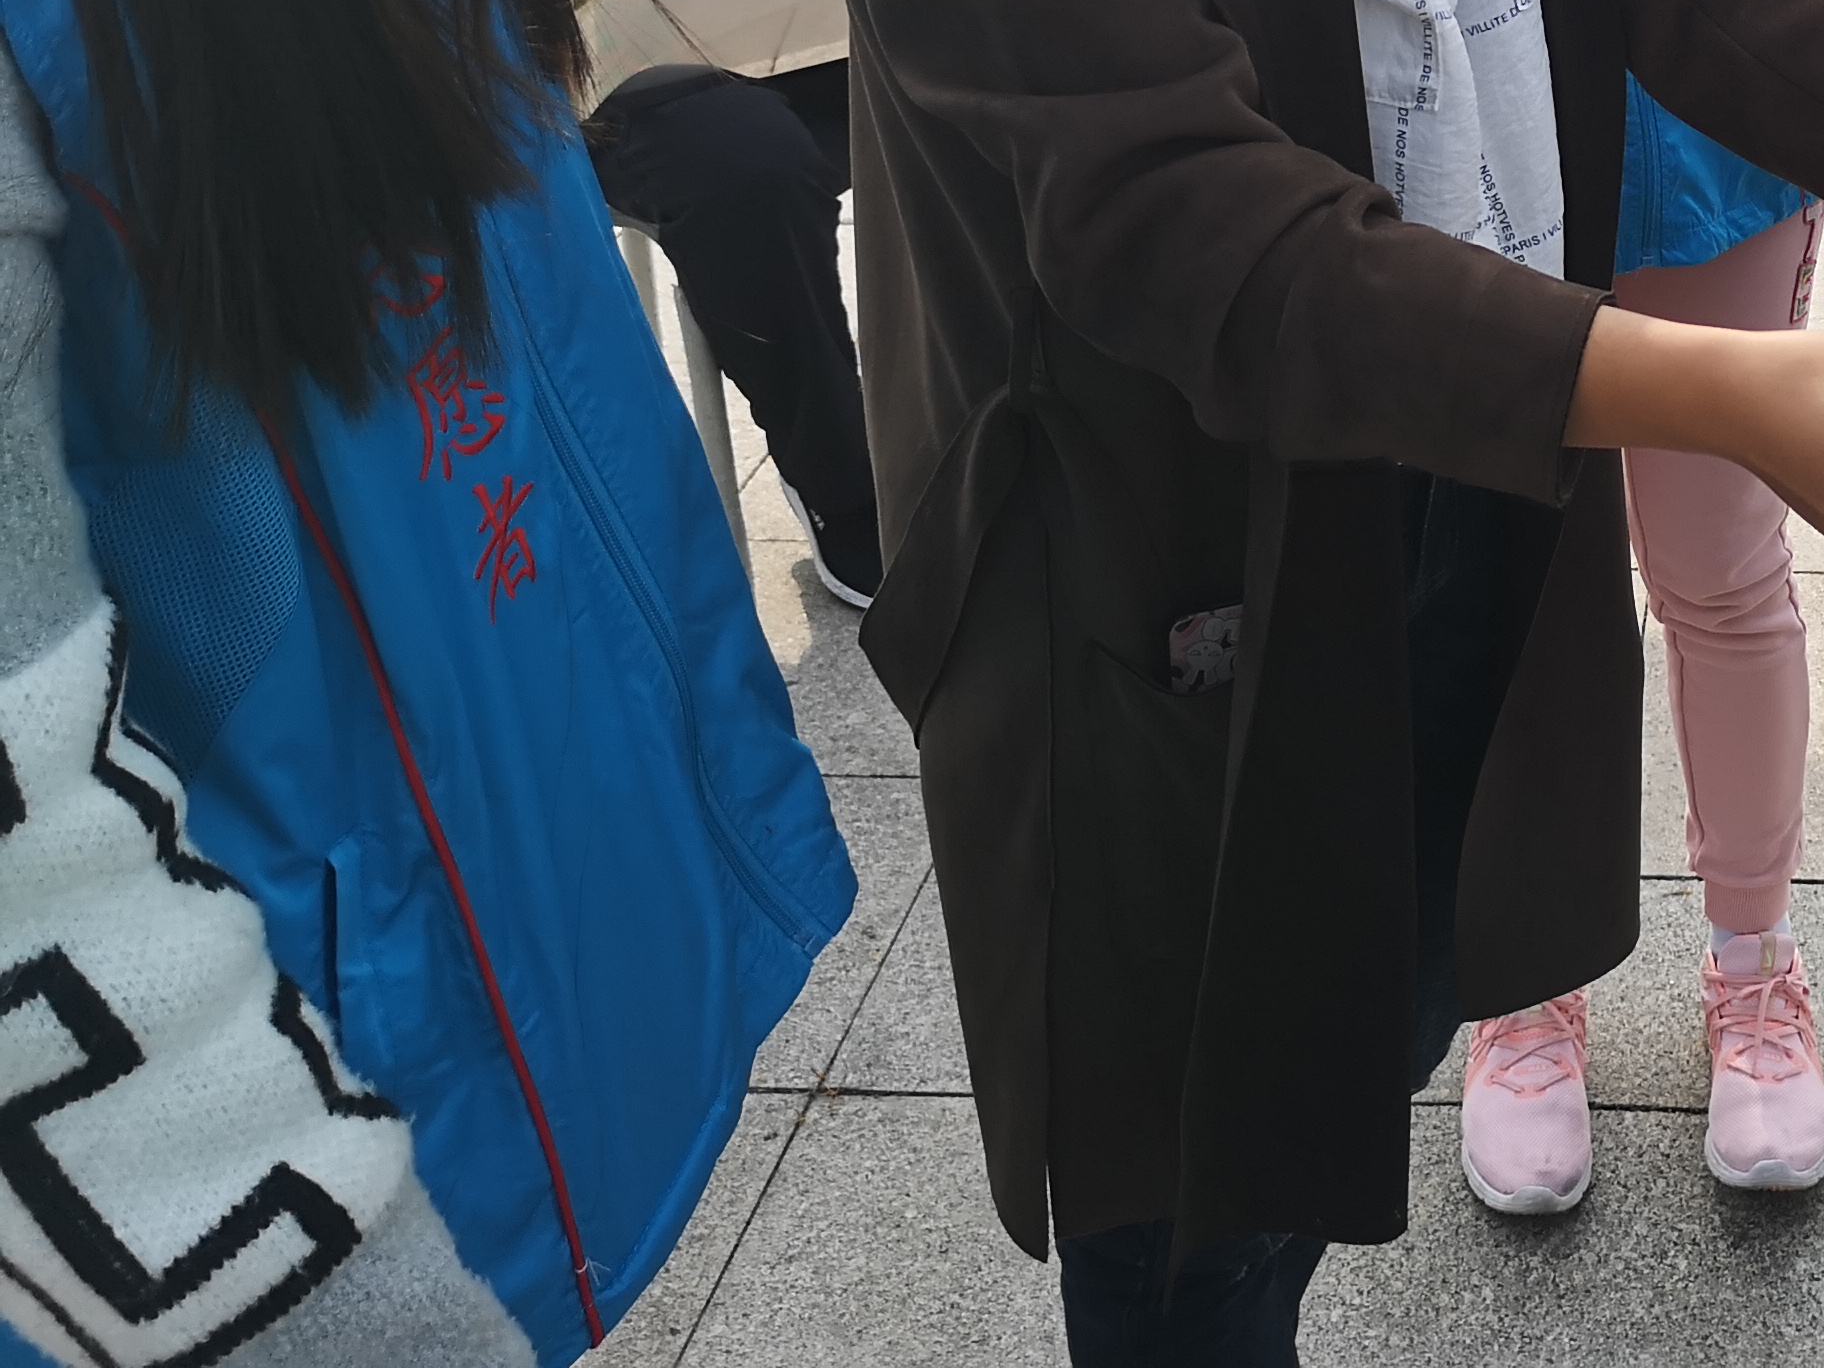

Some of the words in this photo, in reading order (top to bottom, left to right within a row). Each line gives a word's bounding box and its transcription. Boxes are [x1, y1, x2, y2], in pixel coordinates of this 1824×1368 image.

[1465, 14, 1508, 37] VILLITE
[1419, 64, 1432, 83] DE
[1396, 106, 1409, 127] DE
[1394, 129, 1408, 159] NOS
[1480, 164, 1496, 192] NOS
[1490, 193, 1516, 242] HOTVES
[1502, 235, 1541, 255] PARIS
